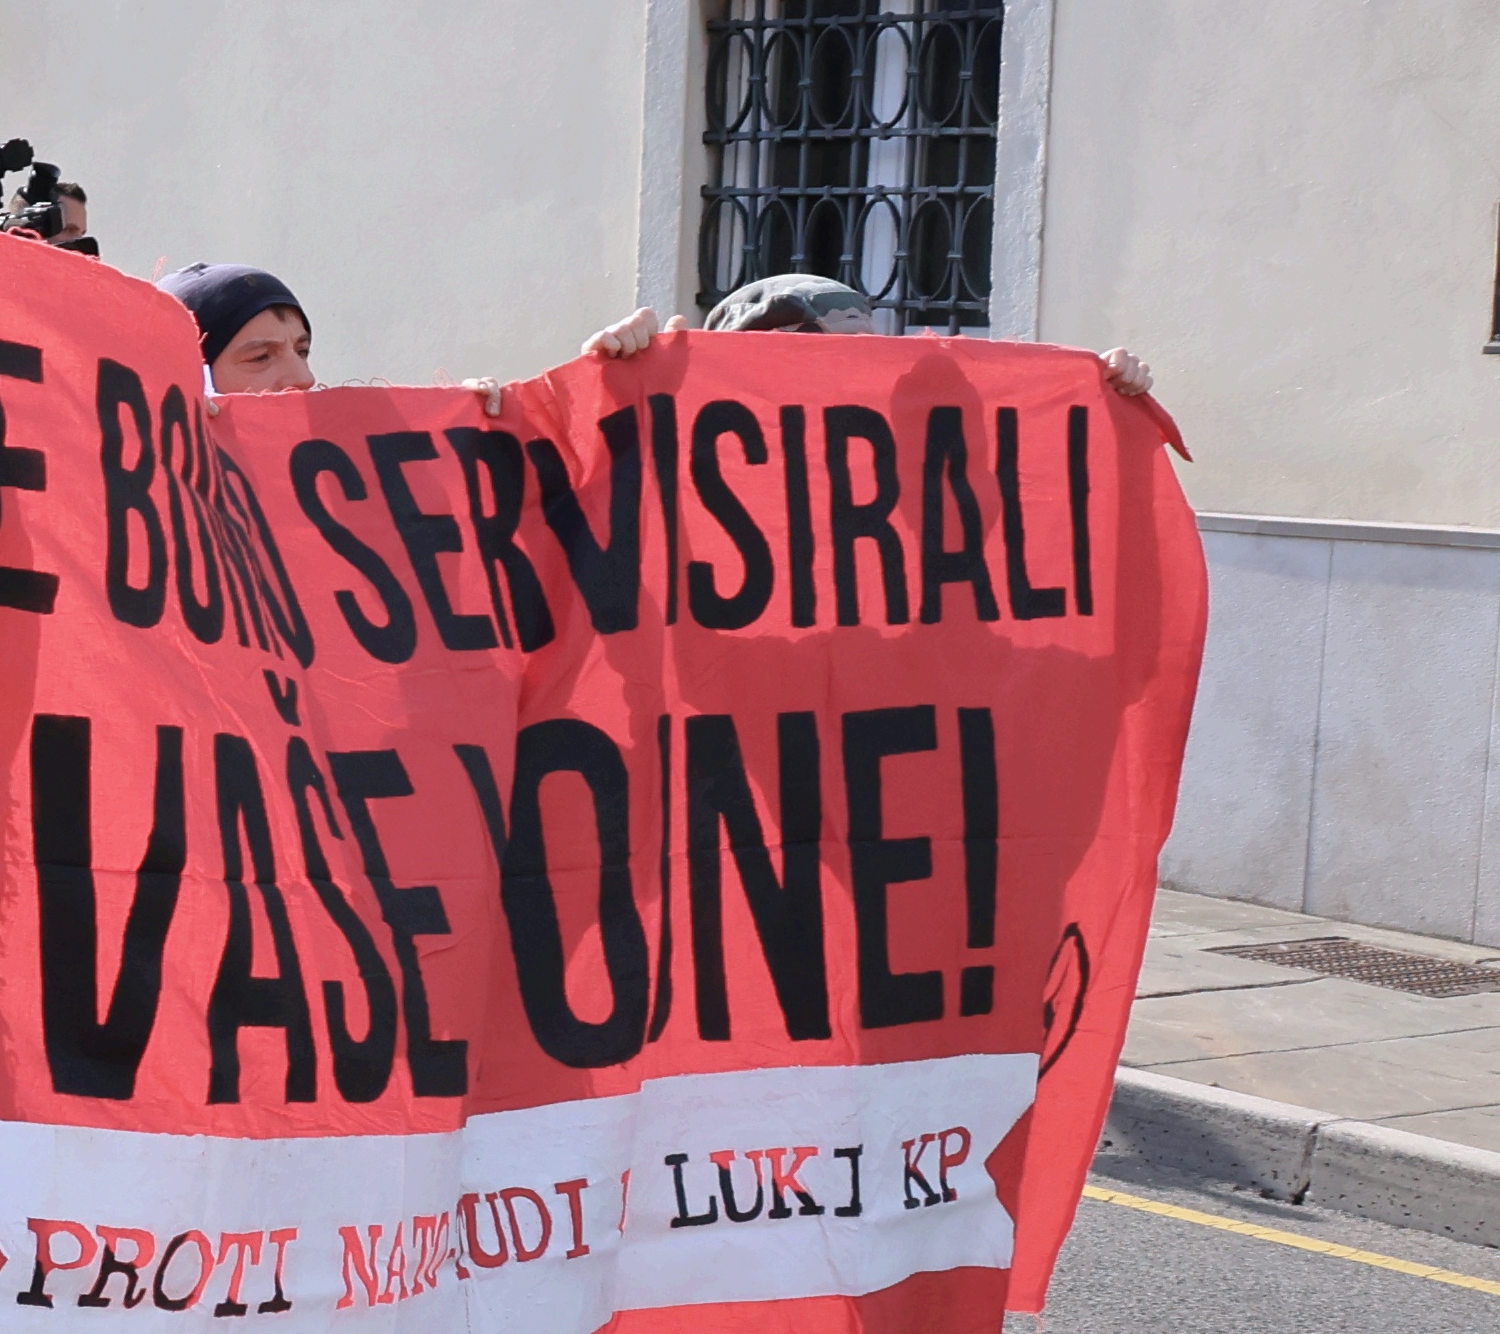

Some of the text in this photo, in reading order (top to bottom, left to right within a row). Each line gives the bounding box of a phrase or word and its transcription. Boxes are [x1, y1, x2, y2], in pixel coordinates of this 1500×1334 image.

[290, 394, 1094, 665] SERVISIRALI
[30, 669, 469, 1105] VAŠE
[16, 1217, 298, 1318] PROTI
[665, 1143, 863, 1229] LUKI
[901, 1125, 972, 1210] KP
